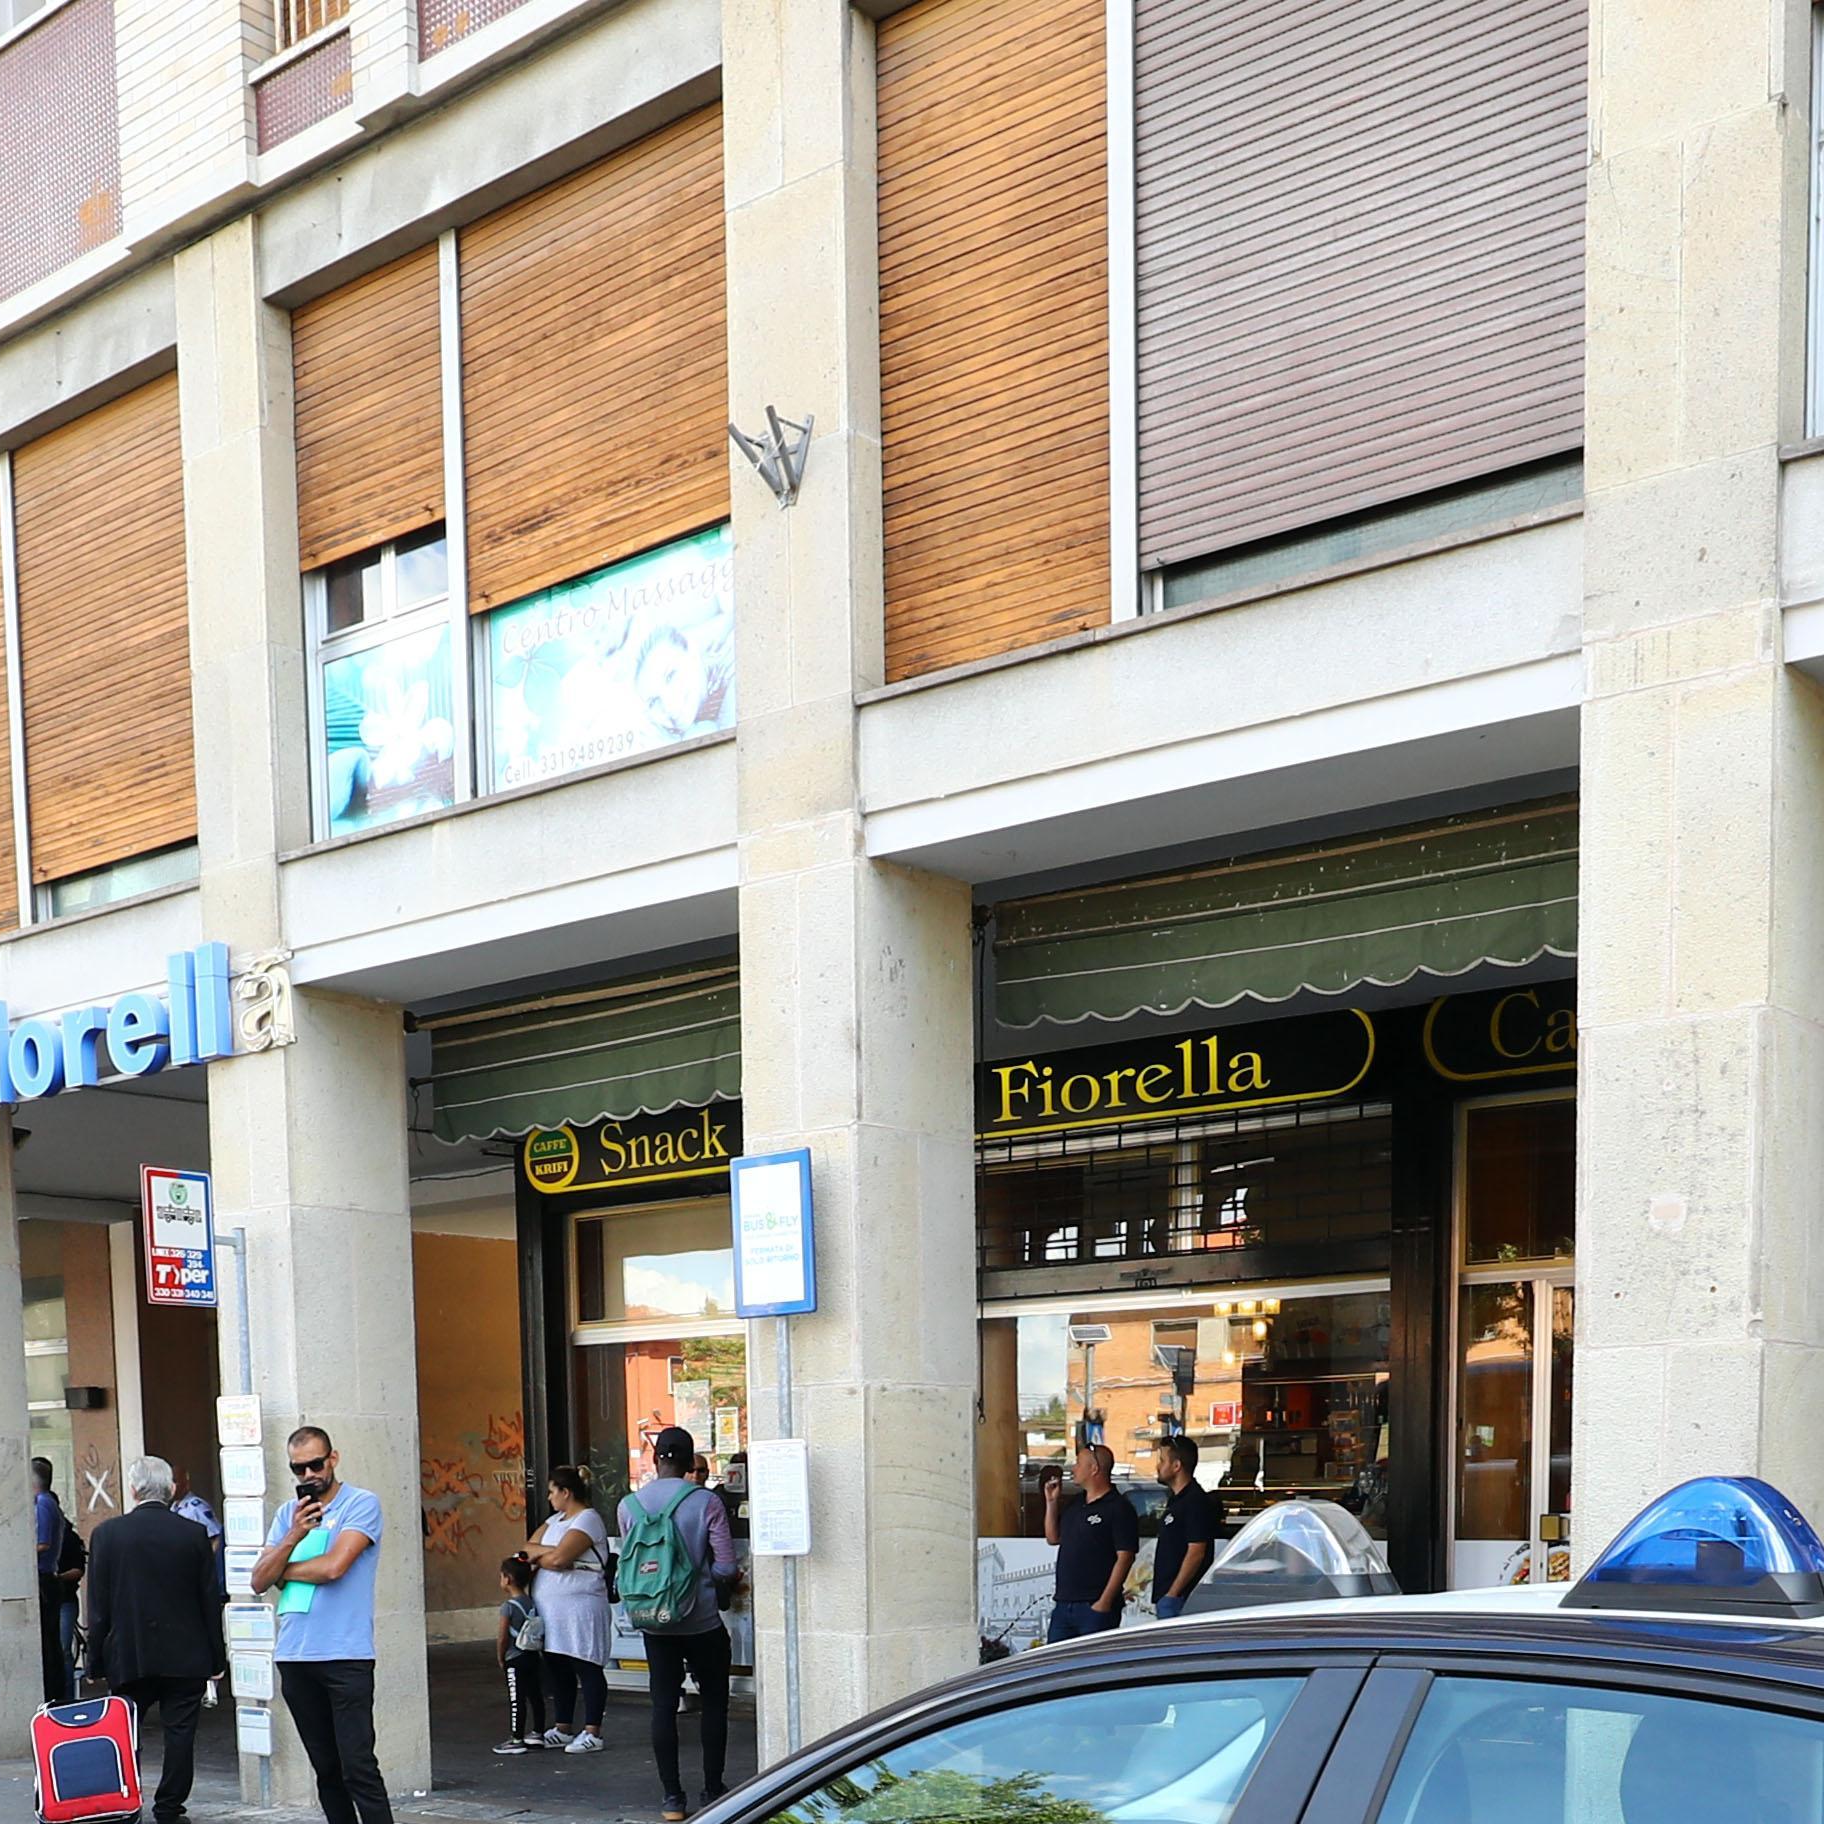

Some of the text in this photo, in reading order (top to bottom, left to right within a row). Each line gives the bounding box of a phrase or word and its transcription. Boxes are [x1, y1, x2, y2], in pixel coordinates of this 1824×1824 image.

[503, 605, 601, 654] Centro
[541, 730, 635, 776] 3319489239
[992, 1034, 1271, 1124] Fiorella
[600, 1108, 729, 1176] Snack
[534, 1160, 569, 1176] KRIFI
[744, 1219, 764, 1231] BUS
[779, 1215, 798, 1227] FLY
